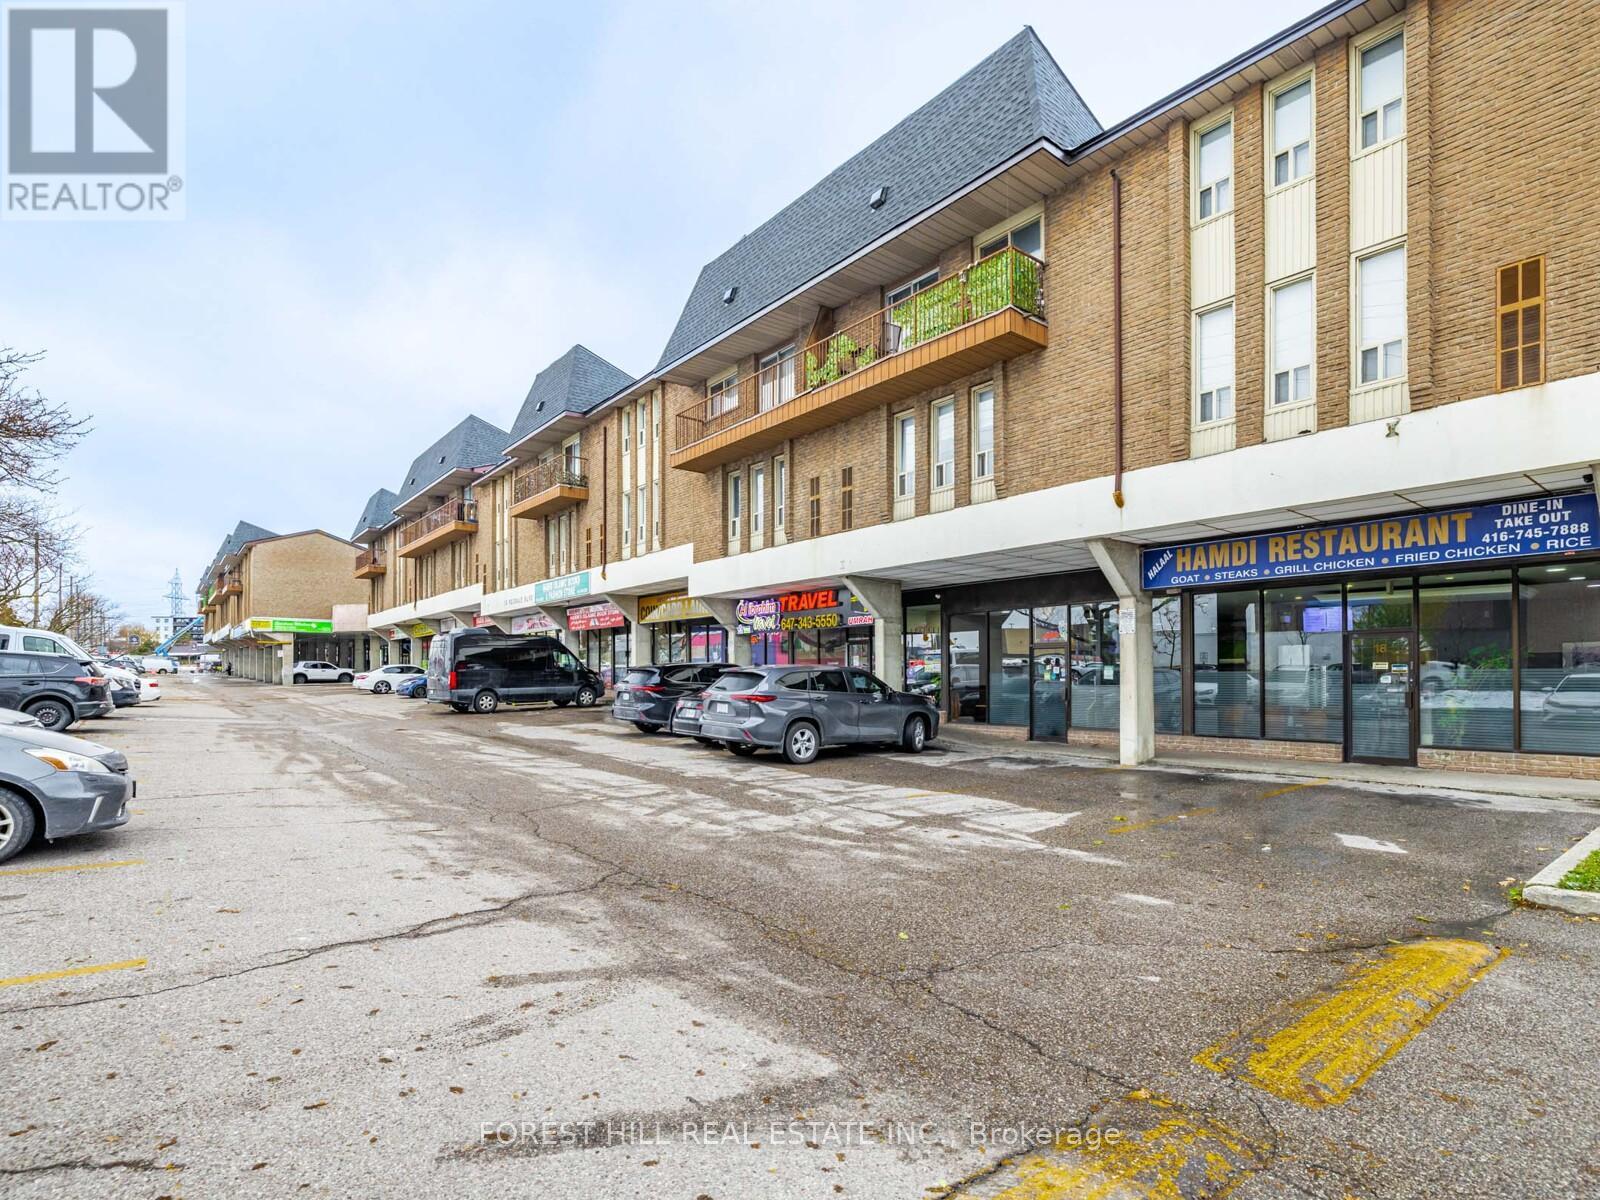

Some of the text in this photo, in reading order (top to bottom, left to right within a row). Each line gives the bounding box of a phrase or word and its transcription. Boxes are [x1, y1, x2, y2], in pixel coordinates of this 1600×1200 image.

[1501, 498, 1564, 516] DINE-IN
[1494, 510, 1572, 529] TAKE OUT
[1175, 512, 1473, 573] HAMDI RESTAURANT
[1481, 522, 1590, 544] 416-745-7888
[1147, 549, 1174, 581] HALAAL
[1170, 536, 1592, 585] GOAT STEAKS GRILL CHICKEN FRIED CHICKEN RICE
[780, 589, 838, 612] TRAVEL
[780, 613, 838, 630] 647-343-5550
[847, 615, 874, 625] UMRAH
